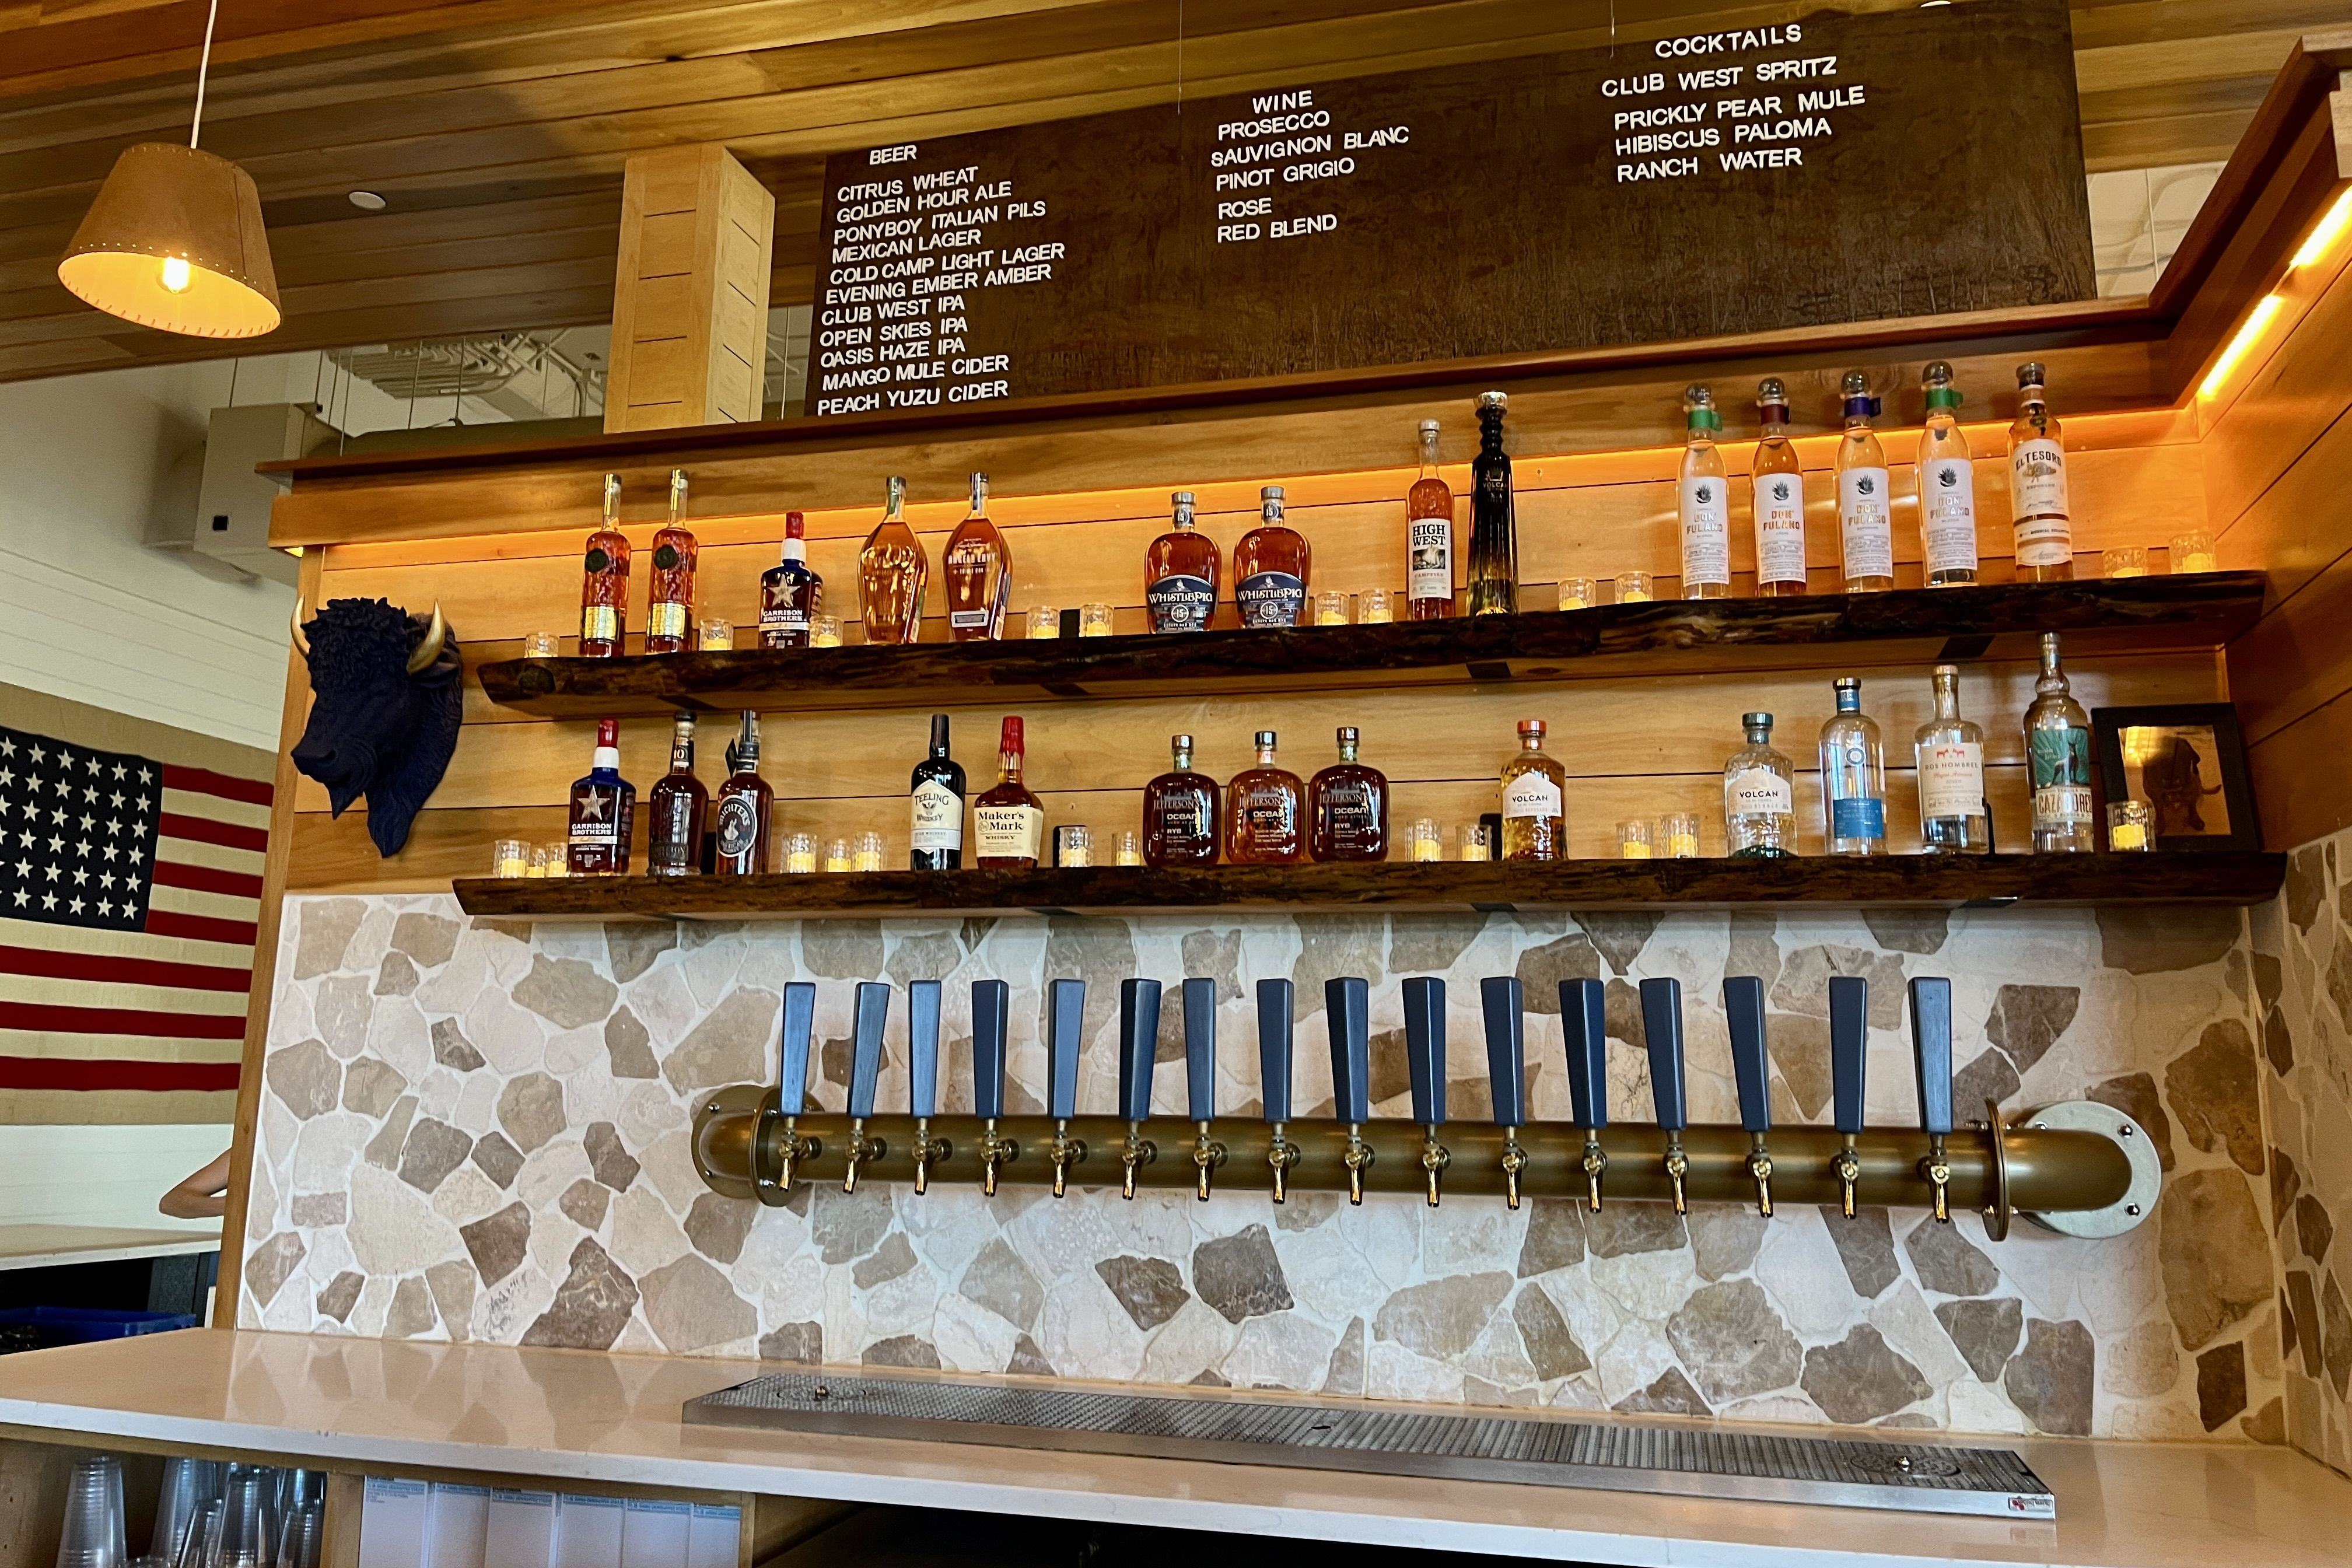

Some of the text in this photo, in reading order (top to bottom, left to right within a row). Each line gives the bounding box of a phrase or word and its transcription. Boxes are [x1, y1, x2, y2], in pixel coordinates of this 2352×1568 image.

[1655, 24, 1801, 58] COCKTAILS
[1602, 56, 1837, 97] CLUB WEST SPRITZ
[1253, 90, 1312, 114] WINE
[1615, 85, 1865, 131] PRICKLY PEAR MULE
[1218, 110, 1329, 141] PROSECCO
[1615, 117, 1832, 156] HIBISCUS PALOMA
[869, 145, 916, 164] BEER
[1211, 126, 1409, 167] SAUVIGNON BLANC
[1216, 158, 1354, 191] PINOT GRIGIO
[1618, 148, 1802, 183] RANCH WATER
[838, 166, 978, 202] CITRUS WHEAT
[836, 181, 1012, 223] GOLDEN HOUR ALE
[1218, 197, 1272, 219] ROSE
[834, 201, 1046, 244] PONYBOY ITALIAN PILS
[1217, 214, 1337, 243] RED BLEND
[832, 229, 981, 264] MEXICAN LAGER
[830, 243, 1065, 285] COLD CAMP LIGHT LAGER
[826, 264, 1051, 304] EVENING EMBER AMBER
[821, 295, 965, 326] CLUB WEST IPA
[820, 317, 968, 346] OPEN SKIES IPA
[820, 337, 965, 368] OASIS HAZE IPA
[822, 355, 1009, 391] MANGO MULE CIDER
[817, 380, 1008, 416] PEACH YUZU CIDER
[1177, 513, 1185, 522] 15
[1266, 507, 1273, 517] 15
[1763, 520, 1800, 531] FULANO
[1413, 524, 1445, 537] HIGH
[1413, 536, 1446, 547] WEST
[1687, 524, 1723, 534] FULANO
[1149, 592, 1213, 604] WHISTLEPIG
[1238, 587, 1303, 601] WHISTLEPIG
[1177, 608, 1184, 618] 15
[1265, 606, 1273, 615] 15
[915, 793, 949, 805] TEELING
[1512, 794, 1548, 803] VOLCAN
[916, 813, 943, 822] WHISKEY
[979, 811, 1024, 820] Maker's
[989, 822, 1024, 830] Mark
